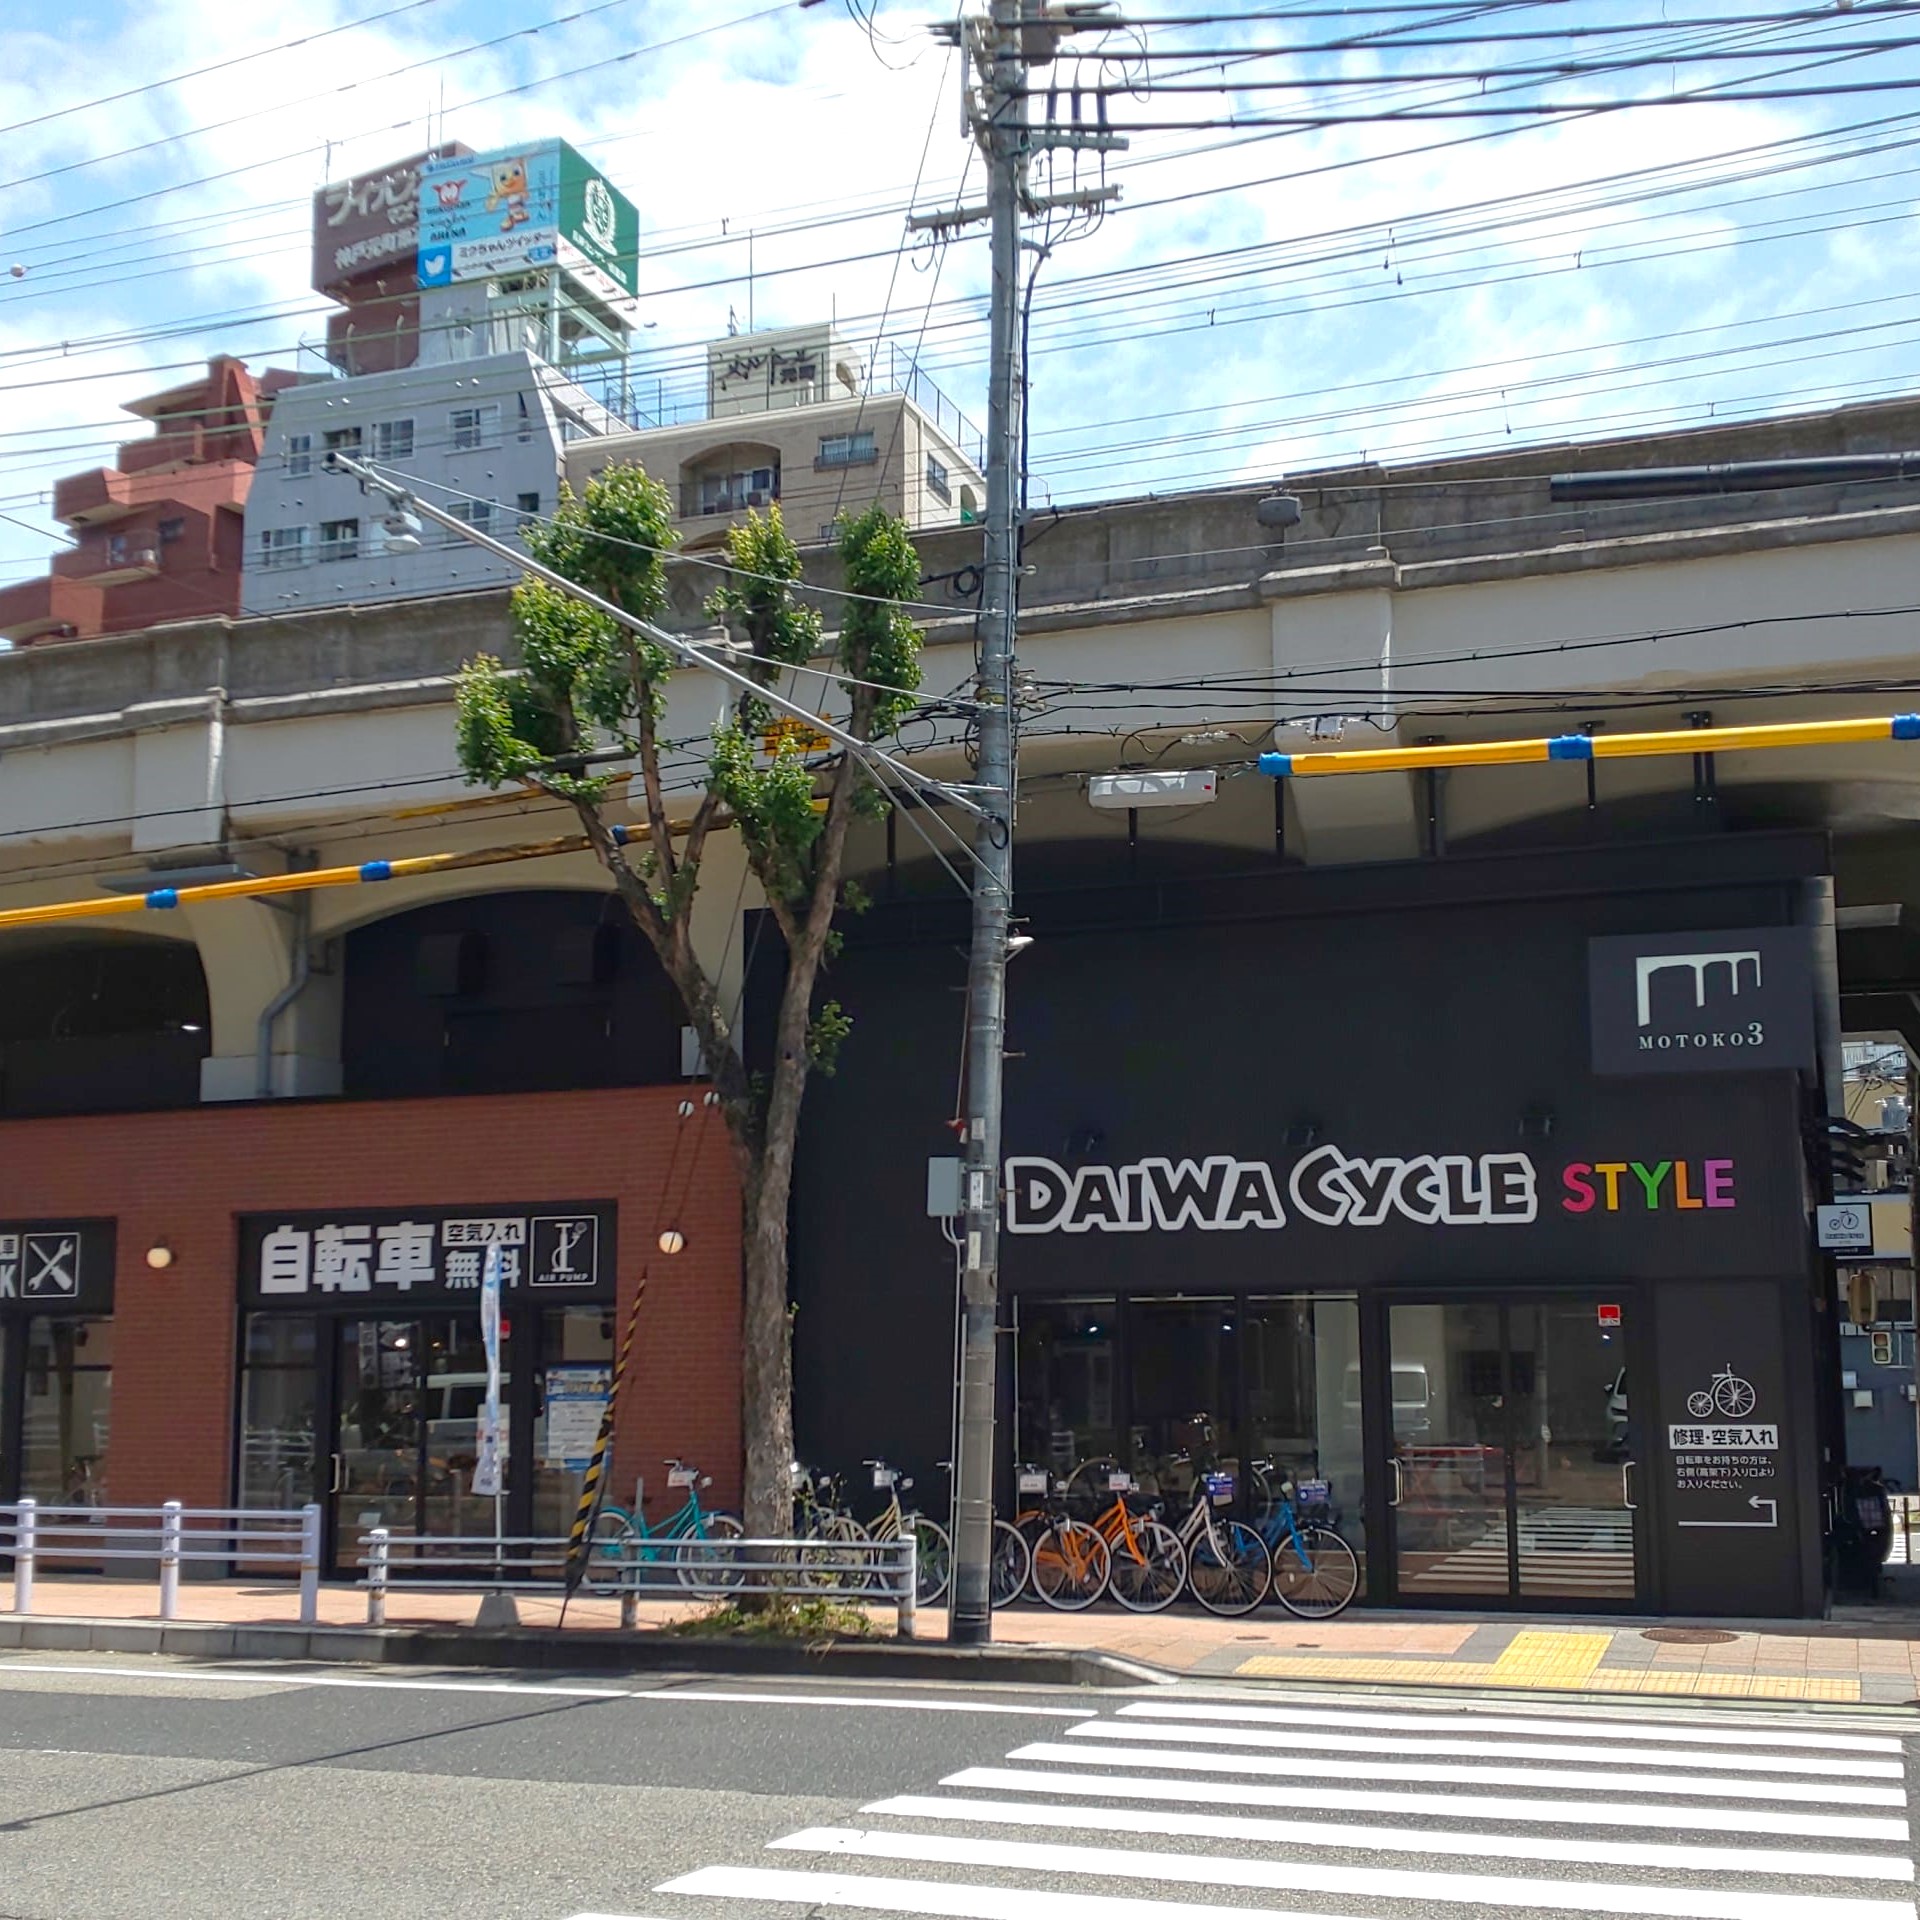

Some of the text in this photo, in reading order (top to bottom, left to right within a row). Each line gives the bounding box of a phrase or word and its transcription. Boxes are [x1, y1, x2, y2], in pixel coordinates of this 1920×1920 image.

[1638, 1022, 1764, 1050] MOTOKO3
[1005, 1155, 1287, 1234] DAIWA
[1289, 1144, 1539, 1226] CYCLE
[1561, 1159, 1737, 1213] STYLE
[447, 1223, 521, 1243] 空気入れ
[260, 1221, 435, 1294] 自転車
[537, 1273, 589, 1282] AIR PUMP
[1673, 1428, 1774, 1446] 修理・空気入れ
[1677, 1479, 1743, 1489] お入りください。
